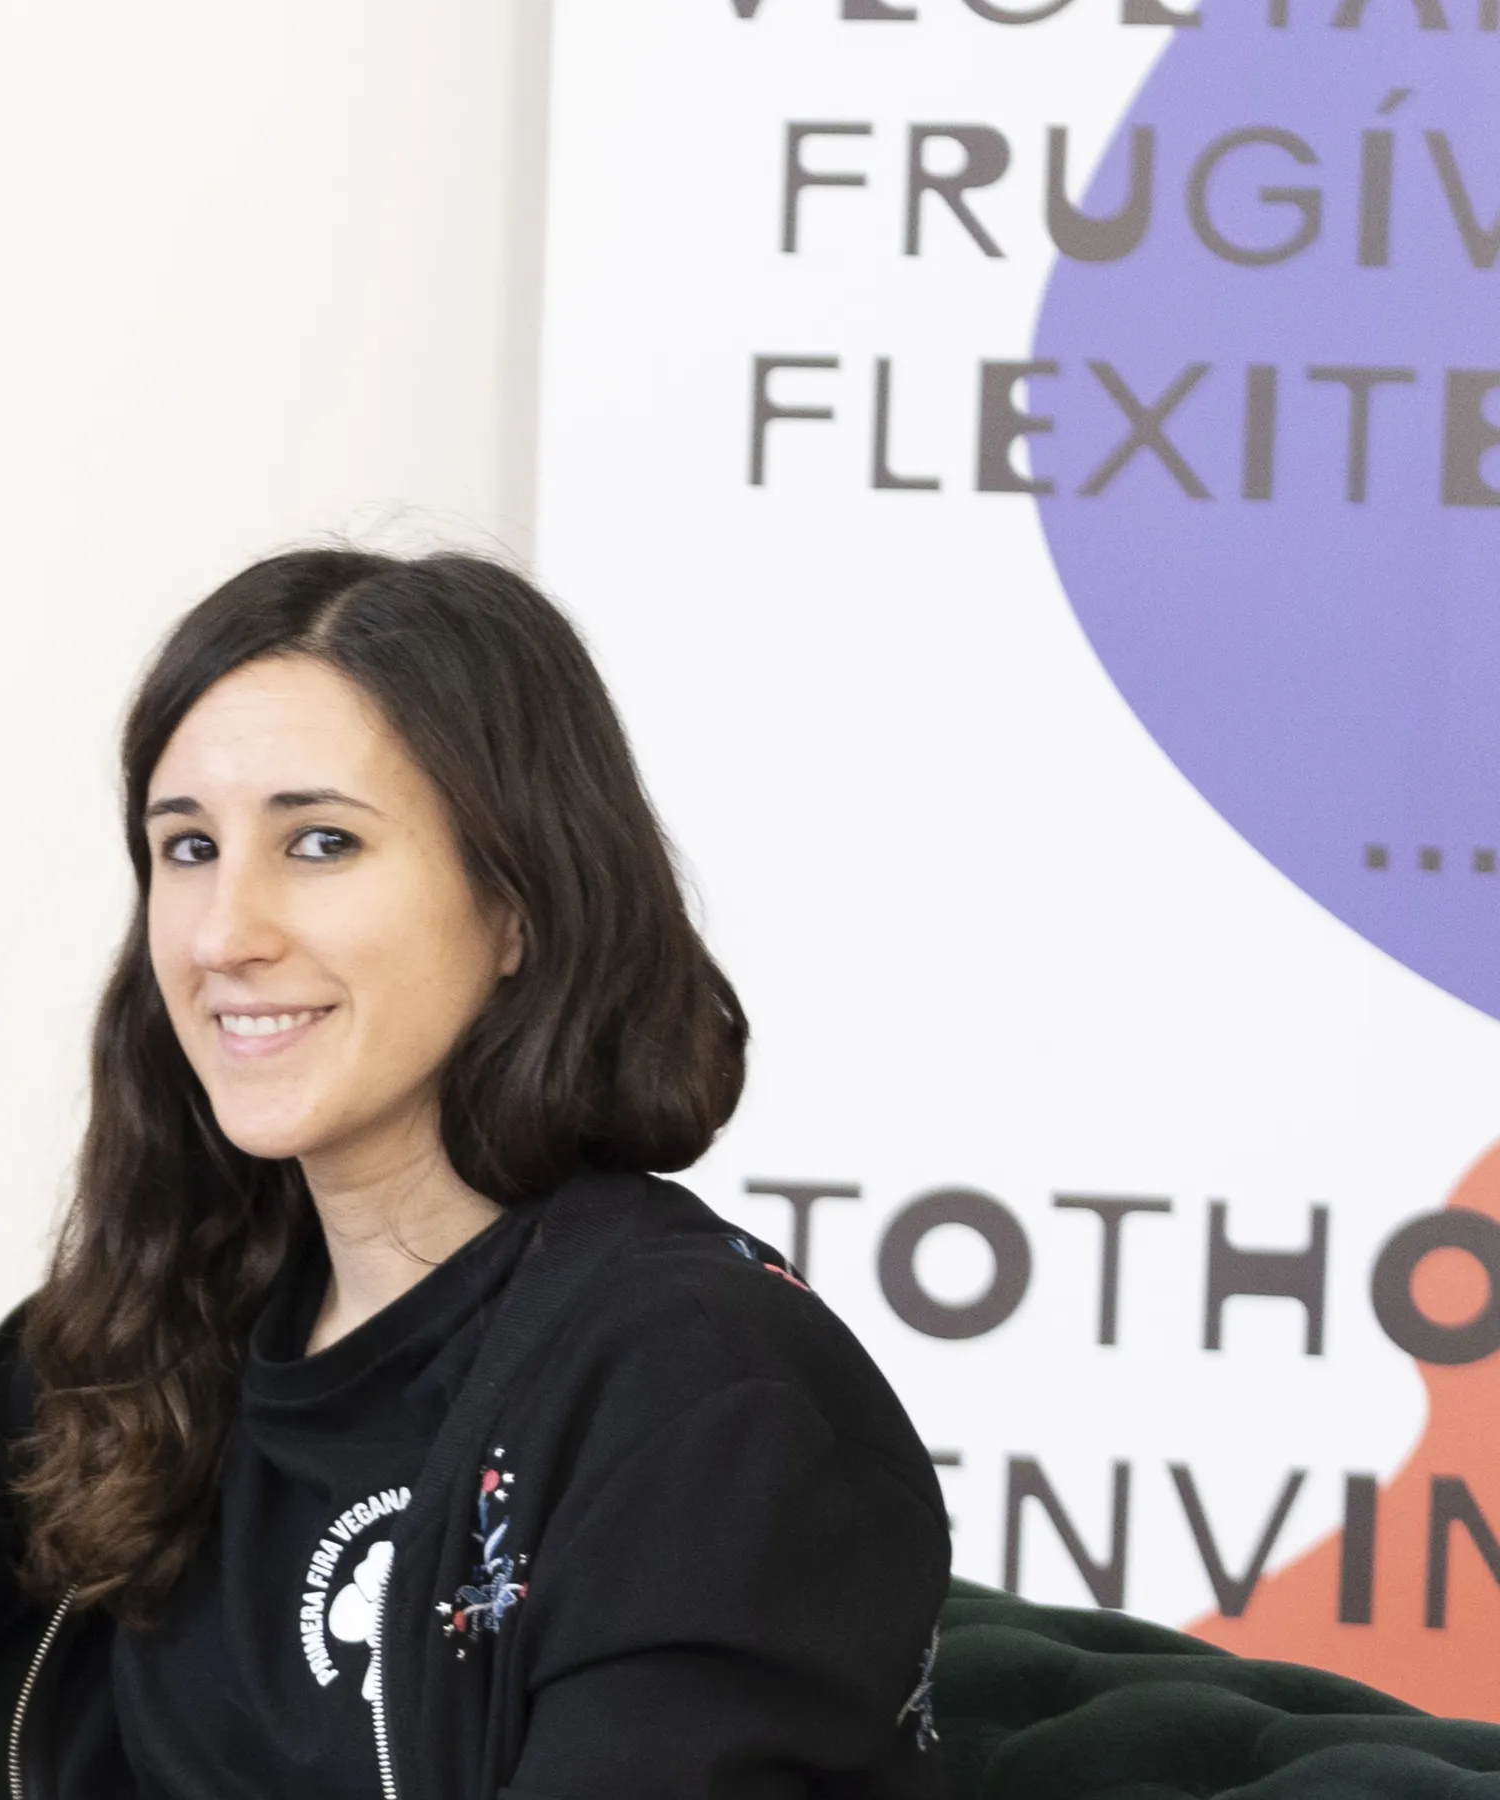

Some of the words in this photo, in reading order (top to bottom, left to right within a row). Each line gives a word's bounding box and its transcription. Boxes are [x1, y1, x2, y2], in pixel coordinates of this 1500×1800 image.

[328, 1486, 412, 1543] VEGANA
[306, 1538, 344, 1589] FIRA
[300, 1590, 340, 1687] PRIMERA
